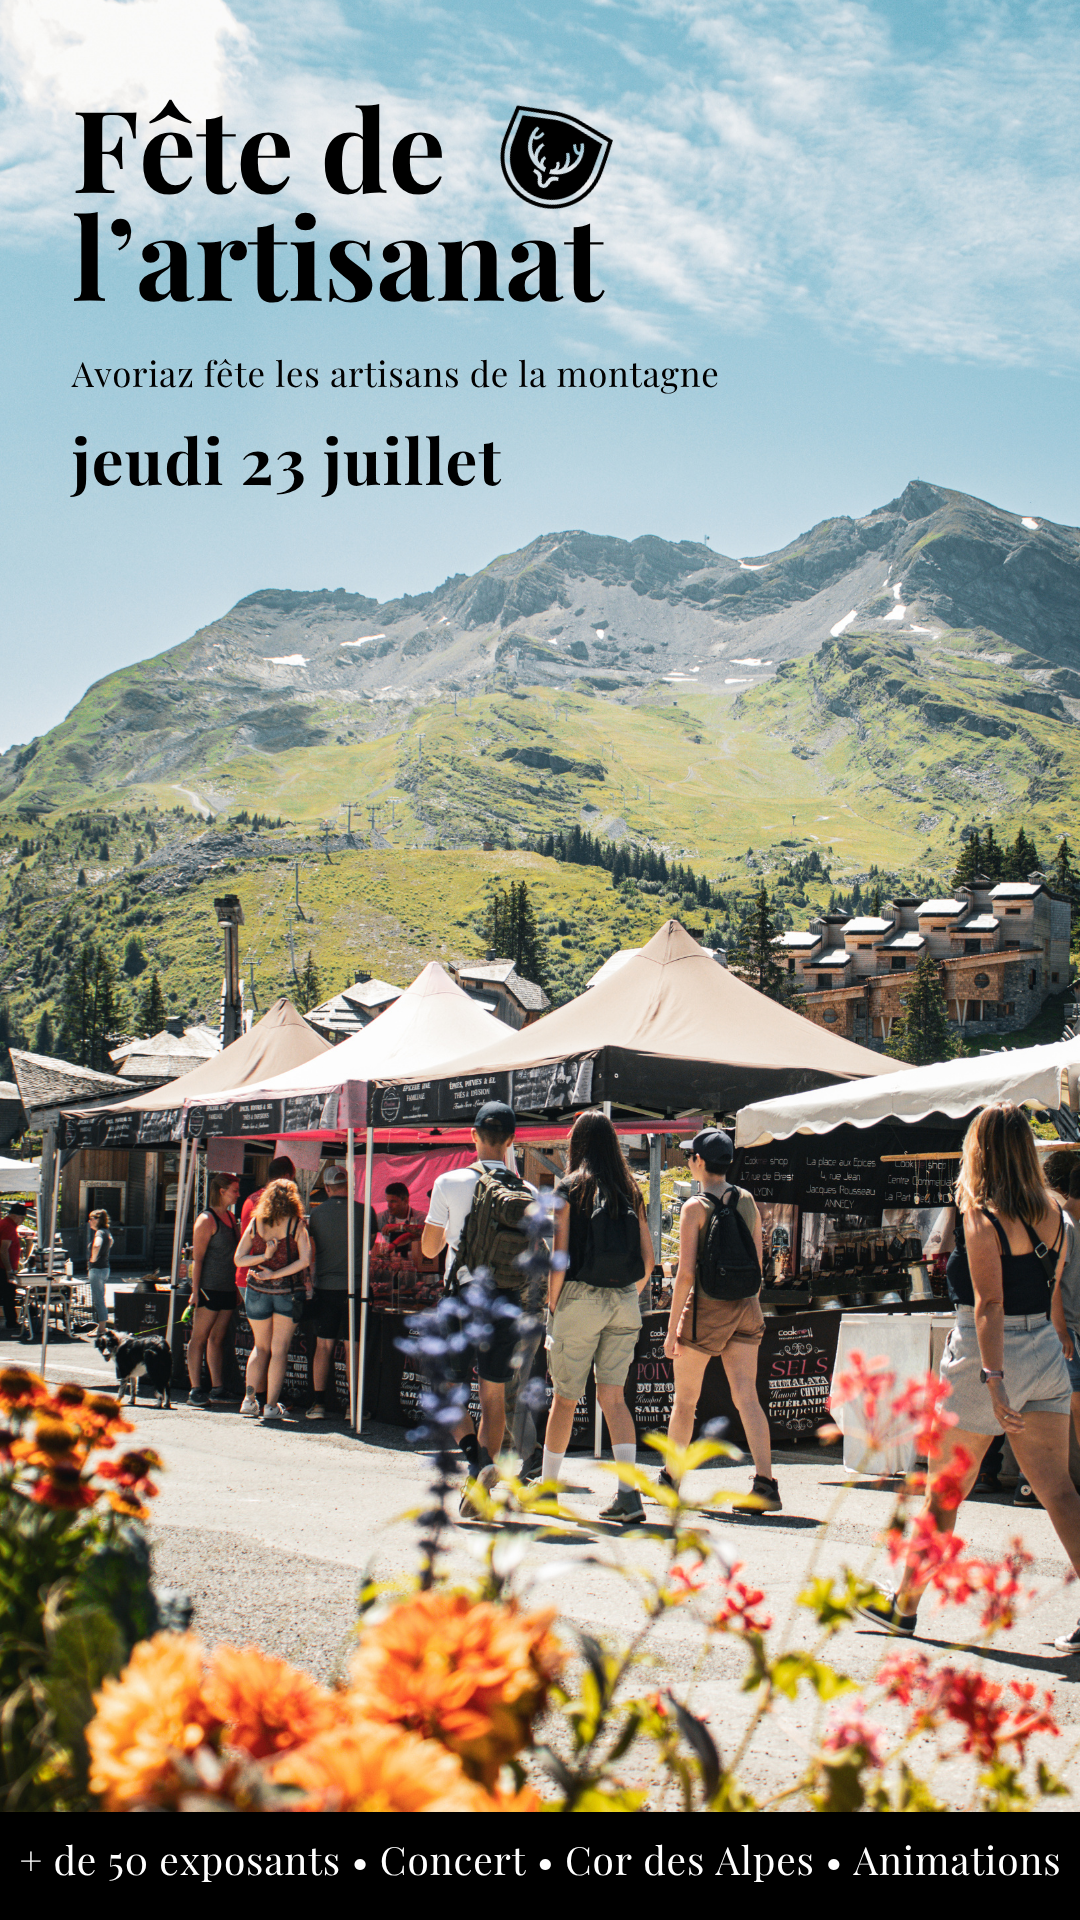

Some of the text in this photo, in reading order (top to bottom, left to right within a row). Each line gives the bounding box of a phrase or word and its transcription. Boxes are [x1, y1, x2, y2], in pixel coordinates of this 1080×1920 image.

[770, 1156, 788, 1168] shop
[806, 1156, 816, 1166] La
[818, 1156, 836, 1168] place
[762, 1172, 772, 1180] de
[774, 1172, 795, 1182] Brest
[820, 1170, 827, 1182] 4,
[843, 1172, 861, 1180] Jean
[888, 1174, 910, 1184] Centre
[754, 1188, 774, 1196] LYON
[806, 1185, 876, 1196] Jacques Rousseau
[884, 1192, 894, 1200] La
[896, 1192, 912, 1202] Part
[824, 1199, 854, 1208] ANNECY
[650, 1326, 666, 1338] Cook
[778, 1326, 808, 1336] Cookme
[636, 1362, 673, 1380] POIV
[770, 1357, 828, 1378] SELS
[636, 1382, 652, 1393] DU
[768, 1376, 829, 1390] HIMALAYA
[800, 1386, 829, 1397] CHYPRE
[768, 1396, 828, 1408] GUÉRANDE
[634, 1406, 674, 1414] SARA
[768, 1406, 830, 1419] trappeurs
